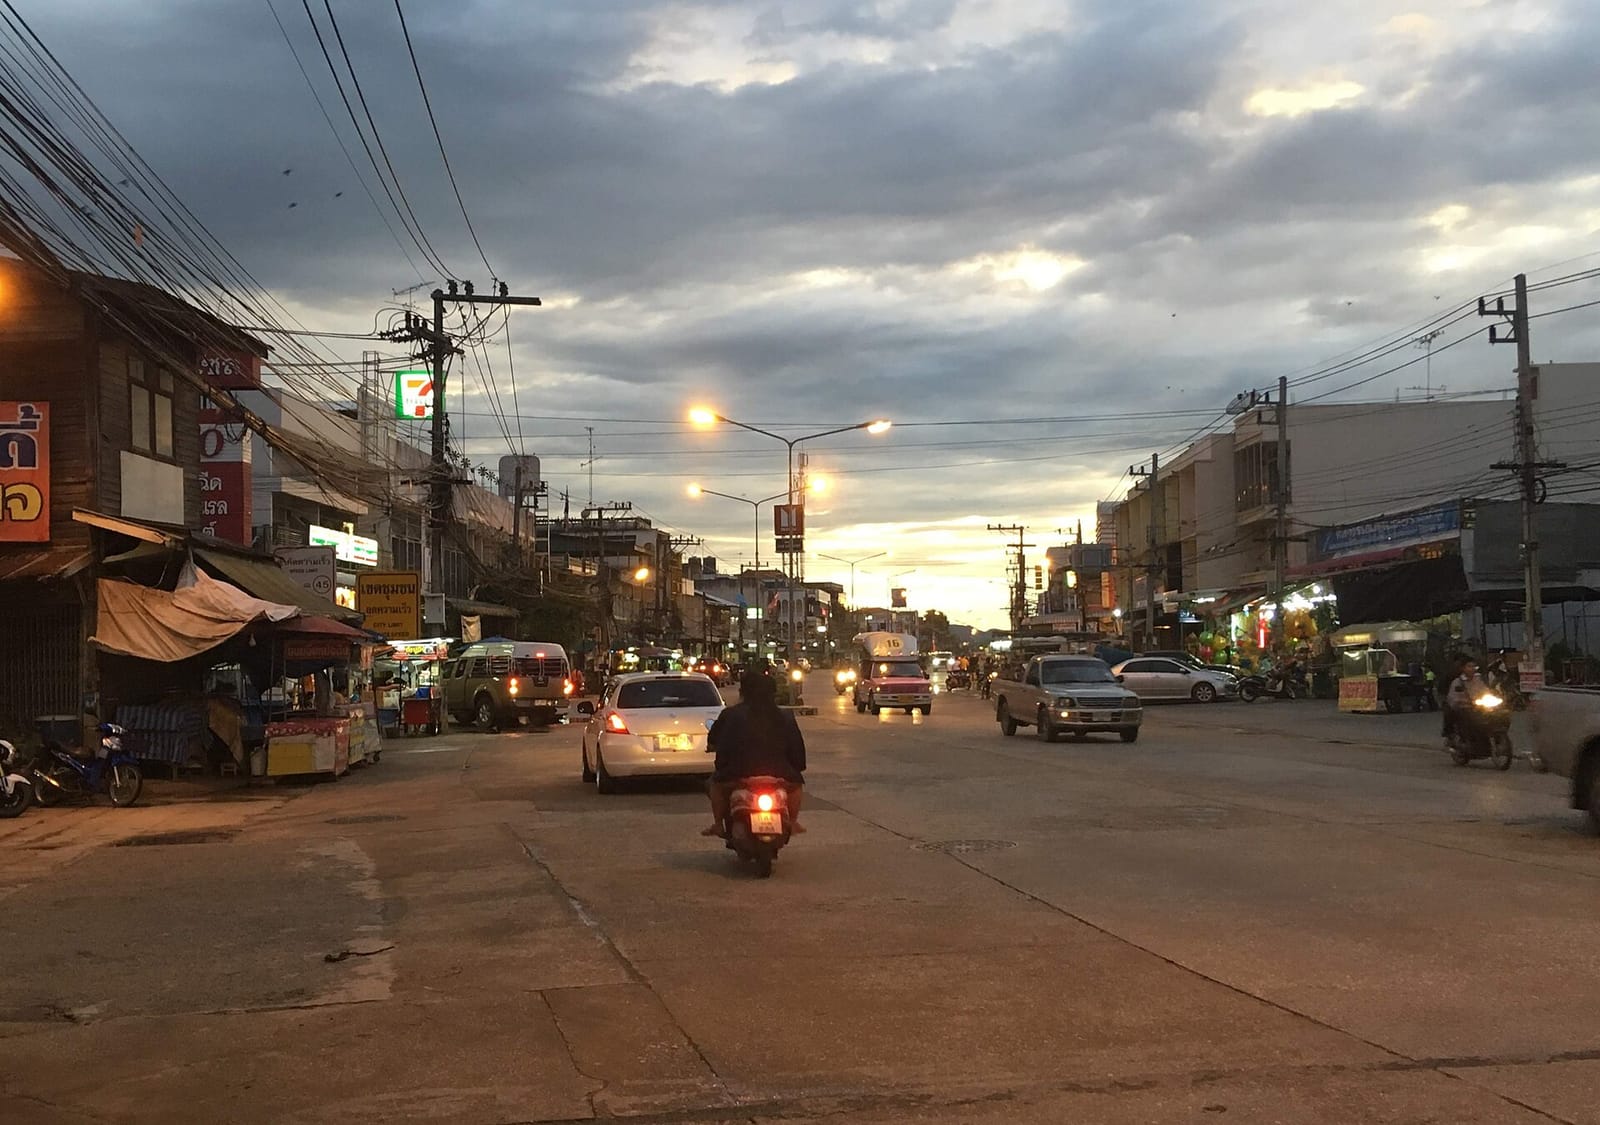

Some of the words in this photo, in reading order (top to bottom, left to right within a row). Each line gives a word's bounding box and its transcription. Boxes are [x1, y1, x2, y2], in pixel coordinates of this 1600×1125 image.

[315, 581, 329, 589] 45
[361, 583, 415, 601] เขตชุมชน
[887, 639, 900, 648] 16
